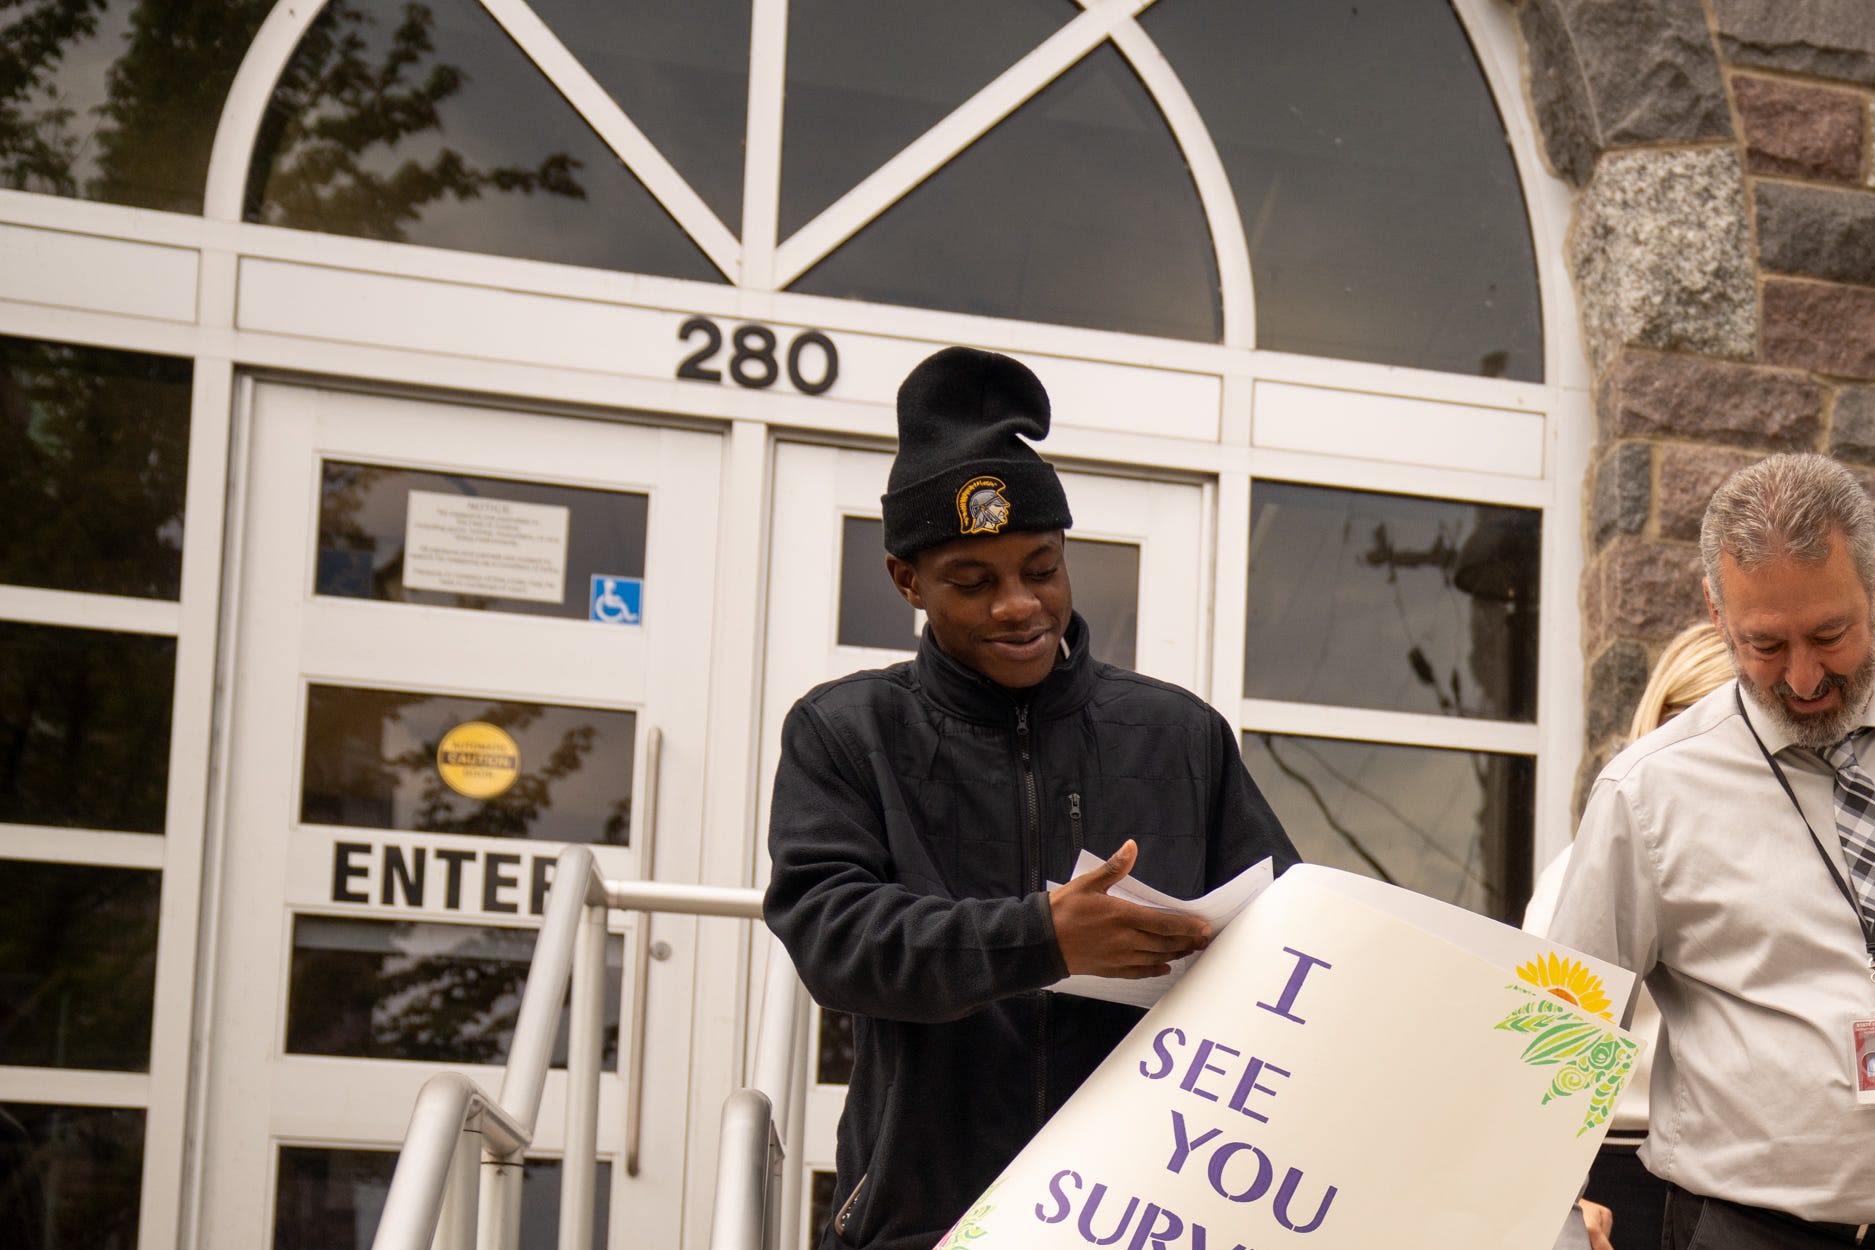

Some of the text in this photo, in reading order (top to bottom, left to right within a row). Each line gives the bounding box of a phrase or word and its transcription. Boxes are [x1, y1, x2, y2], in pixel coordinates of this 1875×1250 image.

[676, 315, 839, 397] 280
[447, 752, 511, 768] CAUTION
[1256, 946, 1331, 1025] I
[1139, 1026, 1291, 1125] SEE
[1167, 1109, 1338, 1234] YOU
